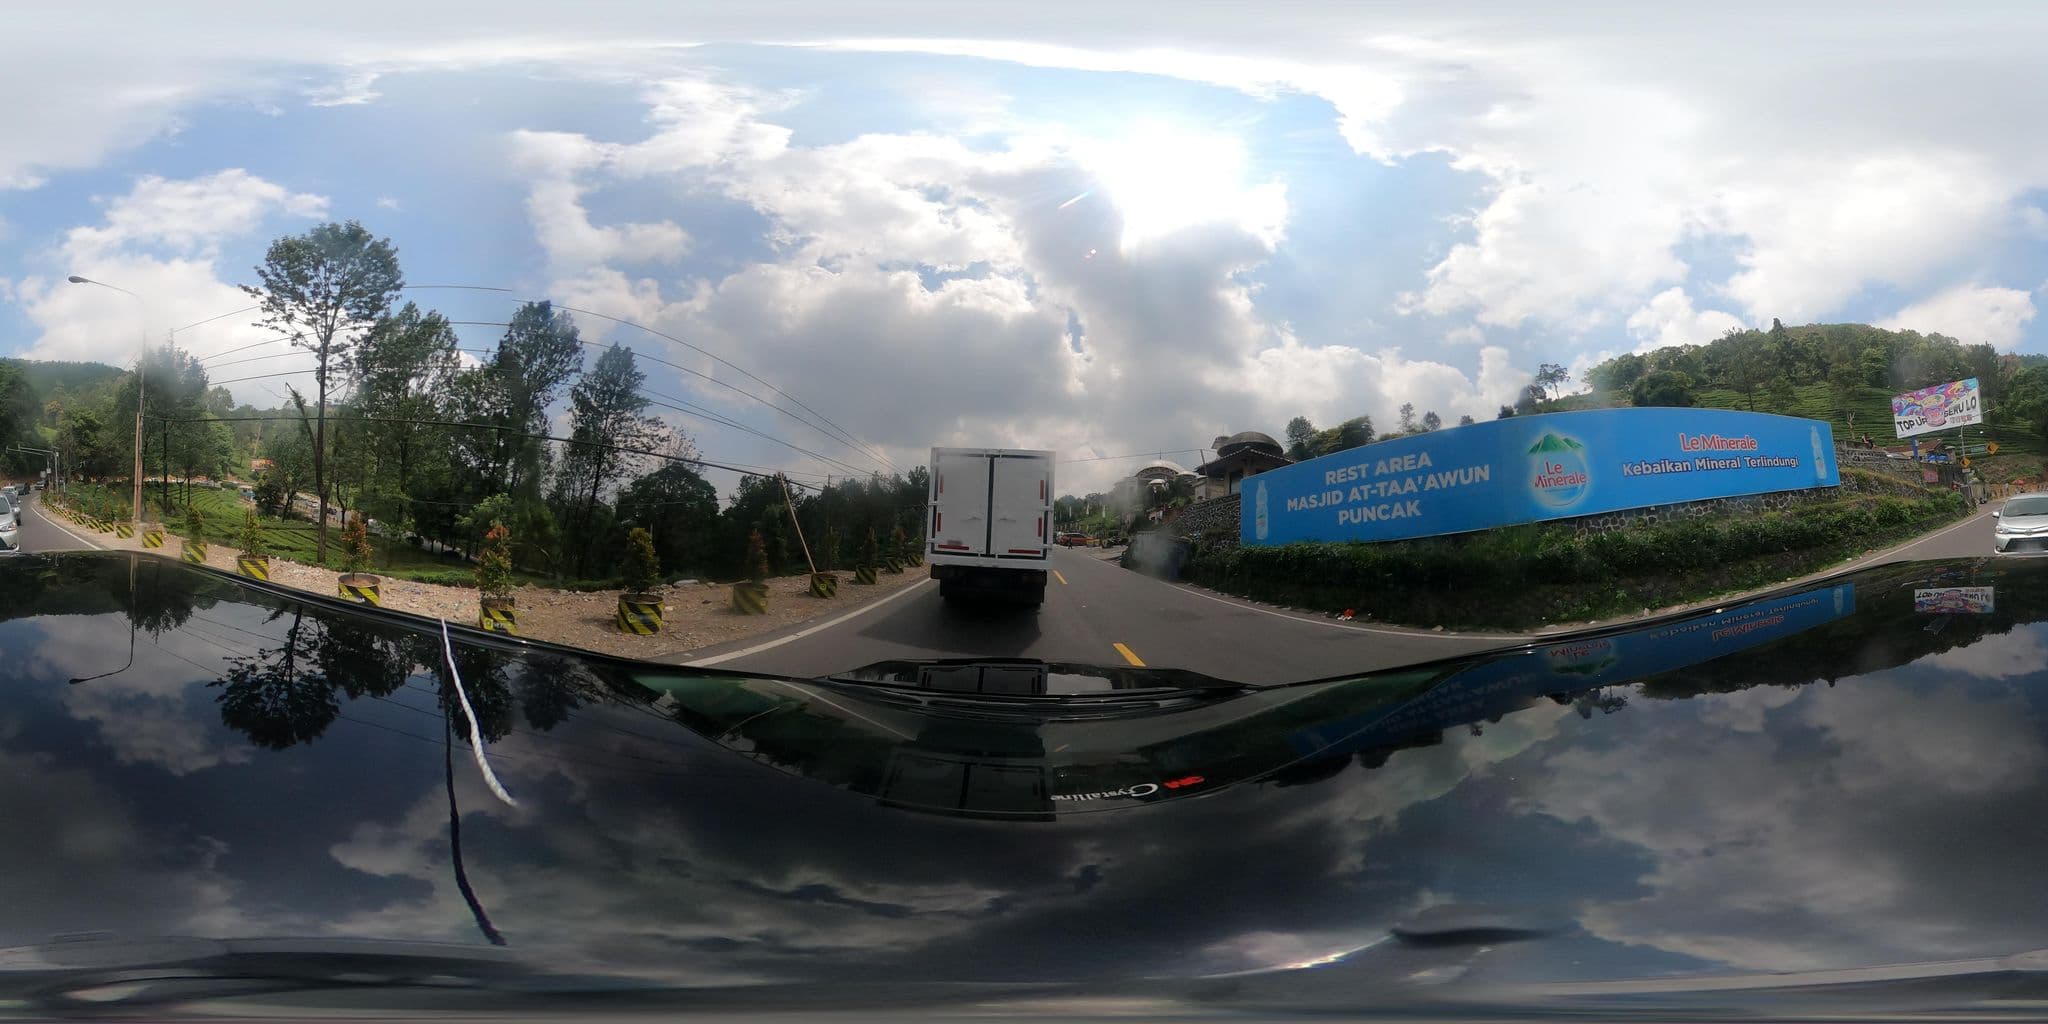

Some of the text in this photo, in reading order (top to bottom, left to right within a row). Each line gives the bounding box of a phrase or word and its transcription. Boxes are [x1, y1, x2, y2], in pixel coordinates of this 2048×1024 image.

[1897, 419, 1915, 432] TOP
[1966, 395, 1977, 411] LO
[1680, 433, 1758, 451] Le Minerale
[1325, 452, 1432, 485] REST AREA
[1545, 461, 1563, 475] Le
[1622, 455, 1800, 476] Kebaikan Mineral Terlindungi
[1287, 464, 1490, 512] MASJID AT-TAA'AWUN
[1534, 471, 1587, 488] Minerale
[1338, 500, 1422, 525] PUNCAK
[1050, 783, 1158, 801] Crystalline
